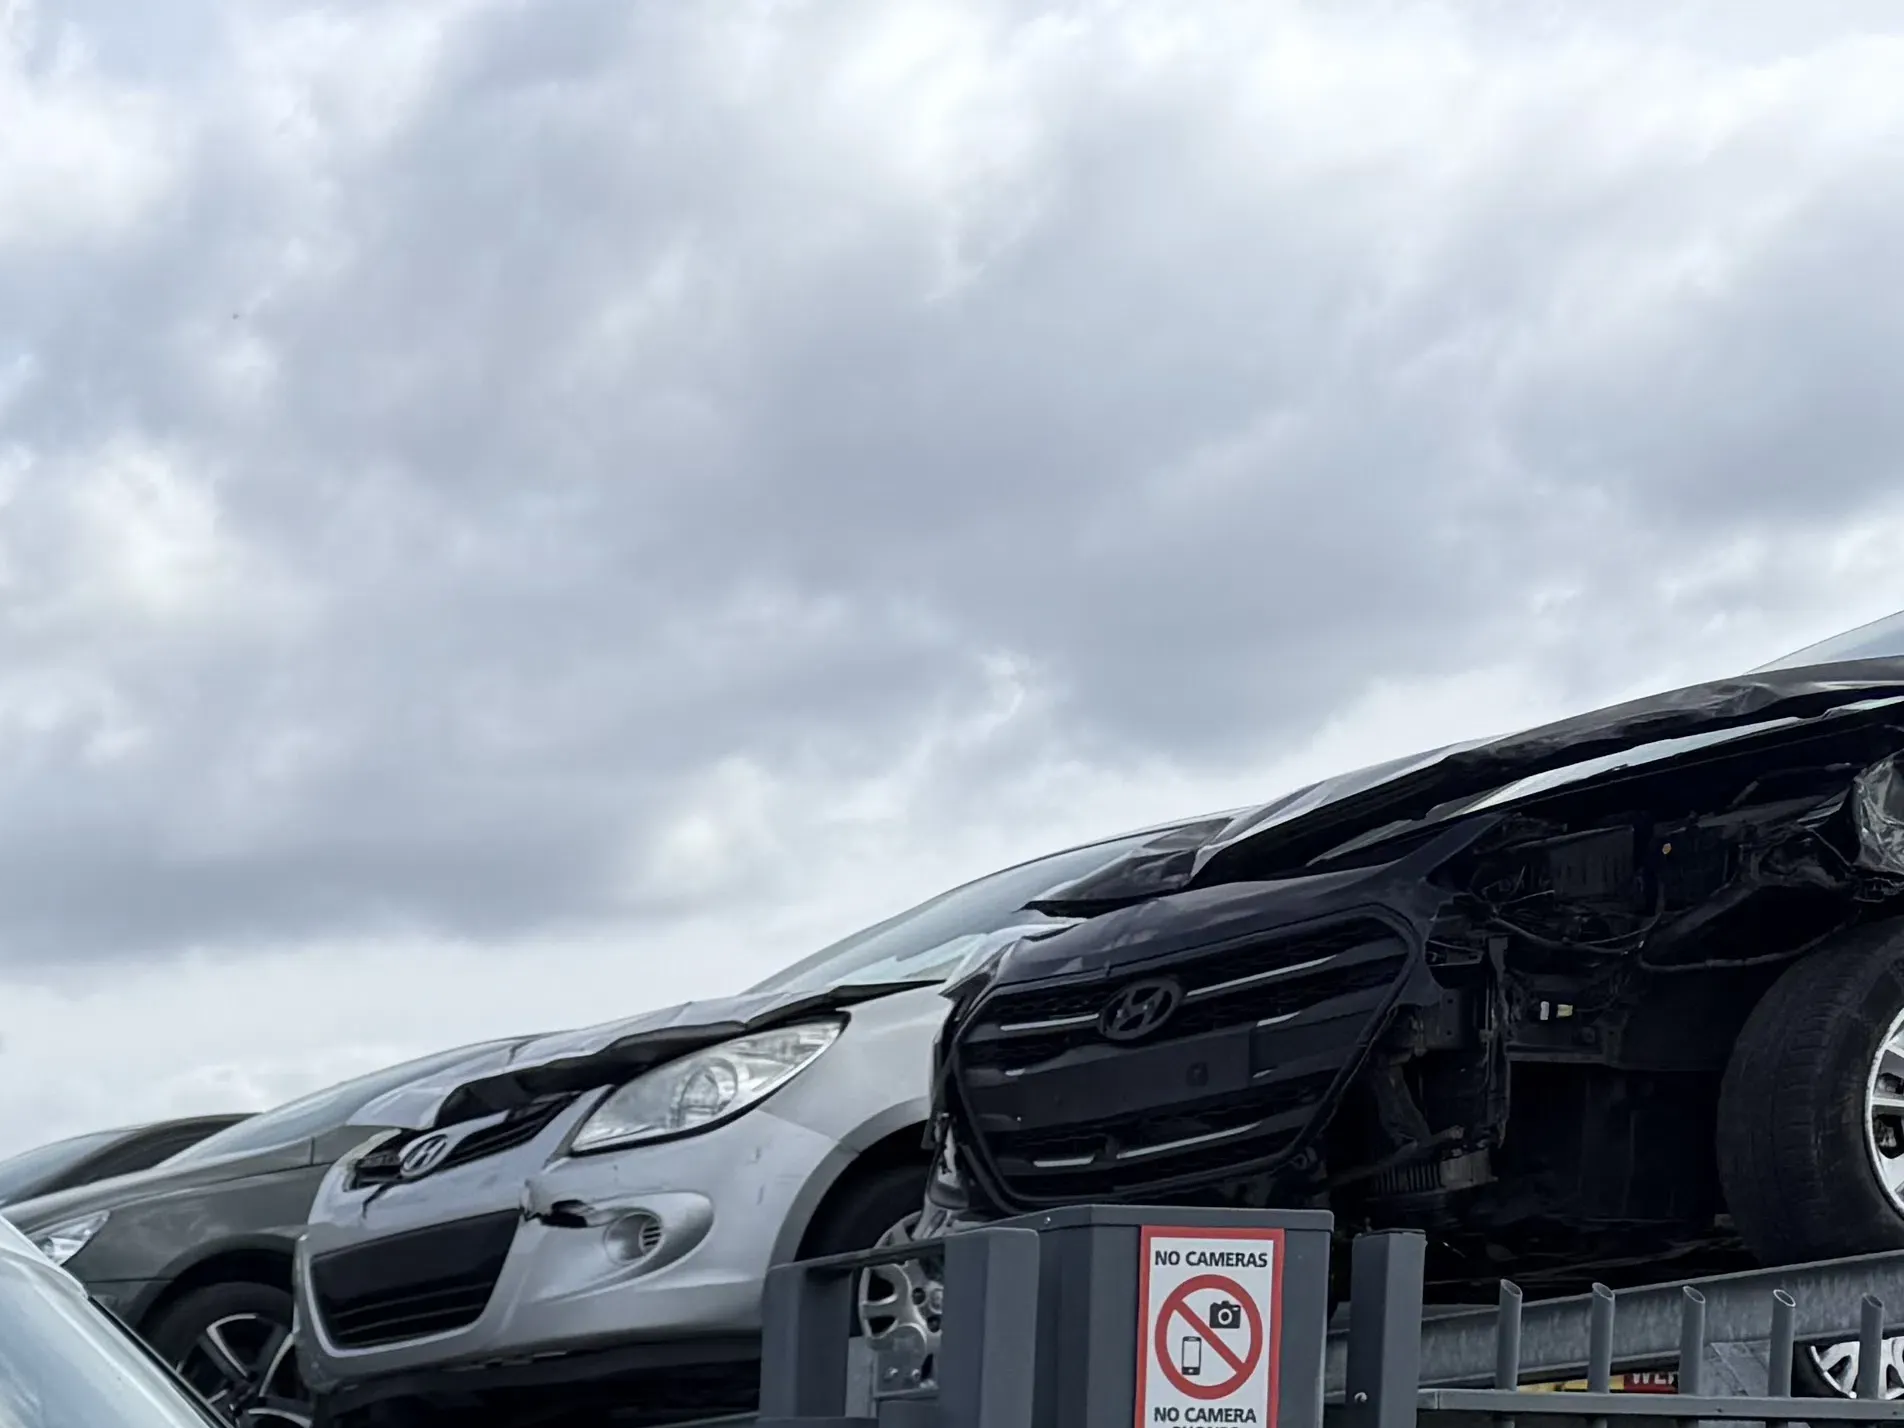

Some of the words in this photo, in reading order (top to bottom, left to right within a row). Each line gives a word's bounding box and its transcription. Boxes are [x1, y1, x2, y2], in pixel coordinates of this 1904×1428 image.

[1154, 1250, 1181, 1266] NO
[1185, 1251, 1268, 1268] CAMERAS
[1154, 1407, 1179, 1423] NO
[1184, 1407, 1256, 1424] CAMERA
